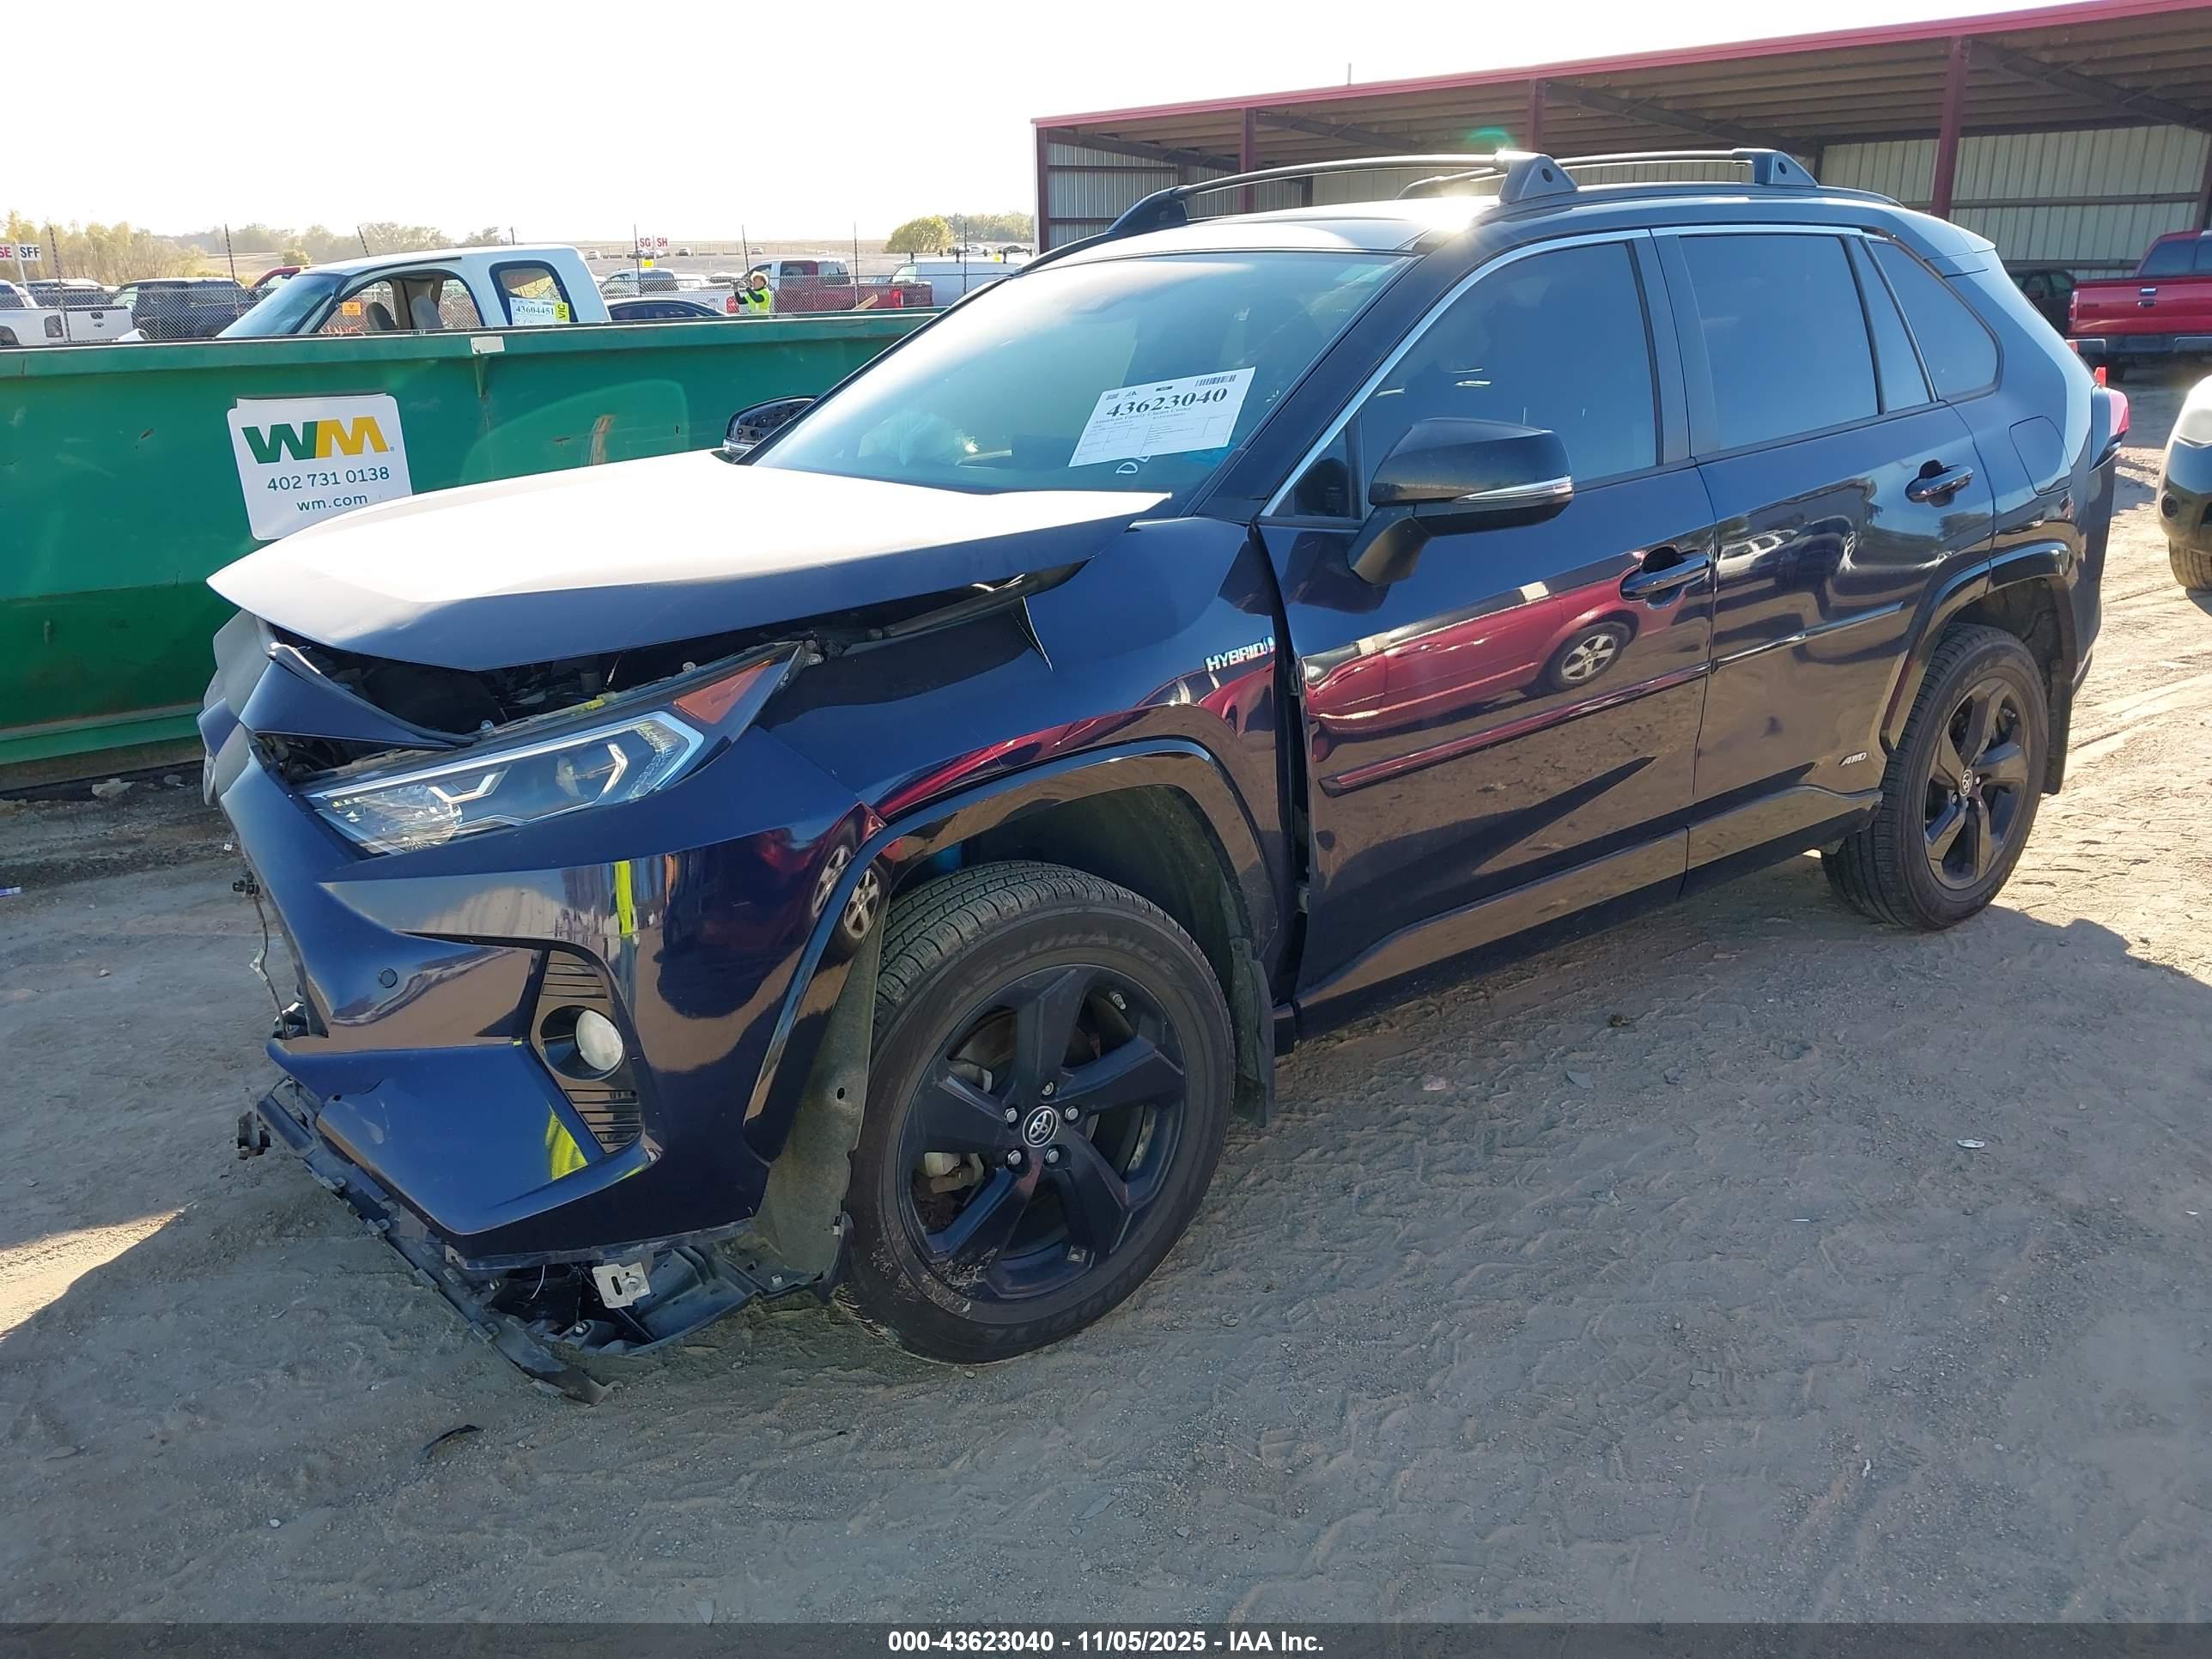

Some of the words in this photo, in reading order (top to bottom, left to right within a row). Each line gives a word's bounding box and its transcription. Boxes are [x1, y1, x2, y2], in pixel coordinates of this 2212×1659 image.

[640, 238, 651, 247] SG
[657, 238, 668, 247] SH
[20, 246, 40, 258] SFF
[557, 303, 566, 319] VIC
[1106, 388, 1228, 417] 43623040
[241, 416, 389, 465] WM
[267, 475, 302, 492] 402
[307, 471, 340, 488] 731
[345, 466, 390, 483] 0138
[296, 495, 368, 512] wm.com
[1206, 641, 1266, 672] HYBRID
[1839, 751, 1868, 767] AWD
